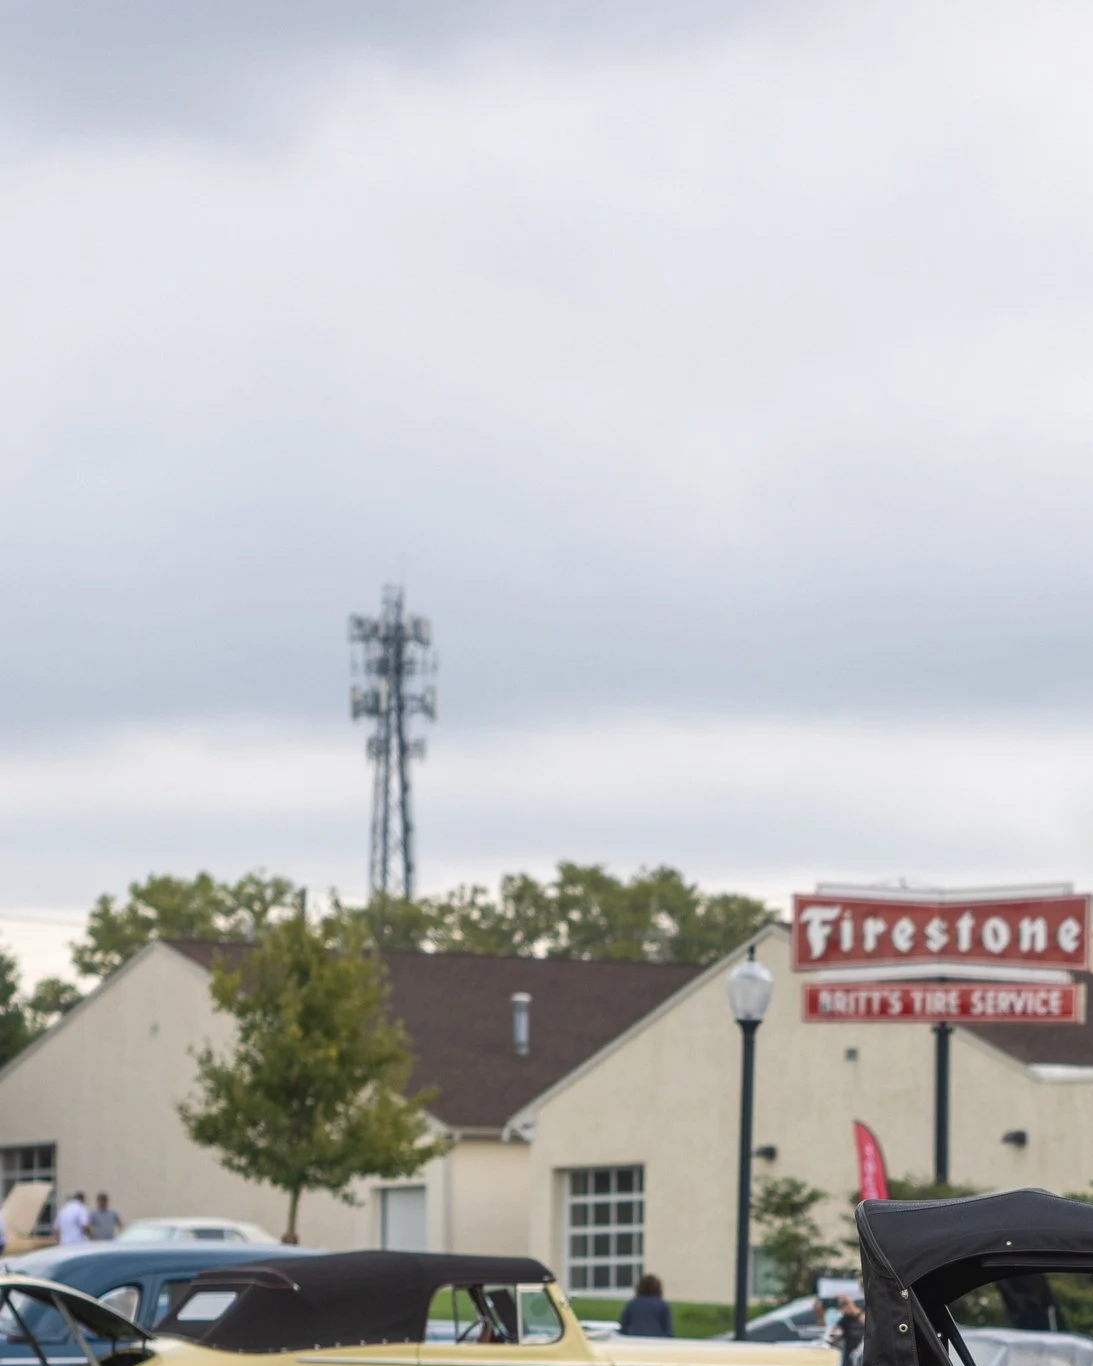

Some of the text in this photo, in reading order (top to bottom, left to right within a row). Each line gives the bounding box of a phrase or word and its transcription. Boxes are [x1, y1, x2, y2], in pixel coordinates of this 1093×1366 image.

[801, 905, 1082, 960] Firestone
[909, 989, 959, 1016] TIRE
[970, 989, 1062, 1016] SERVICE
